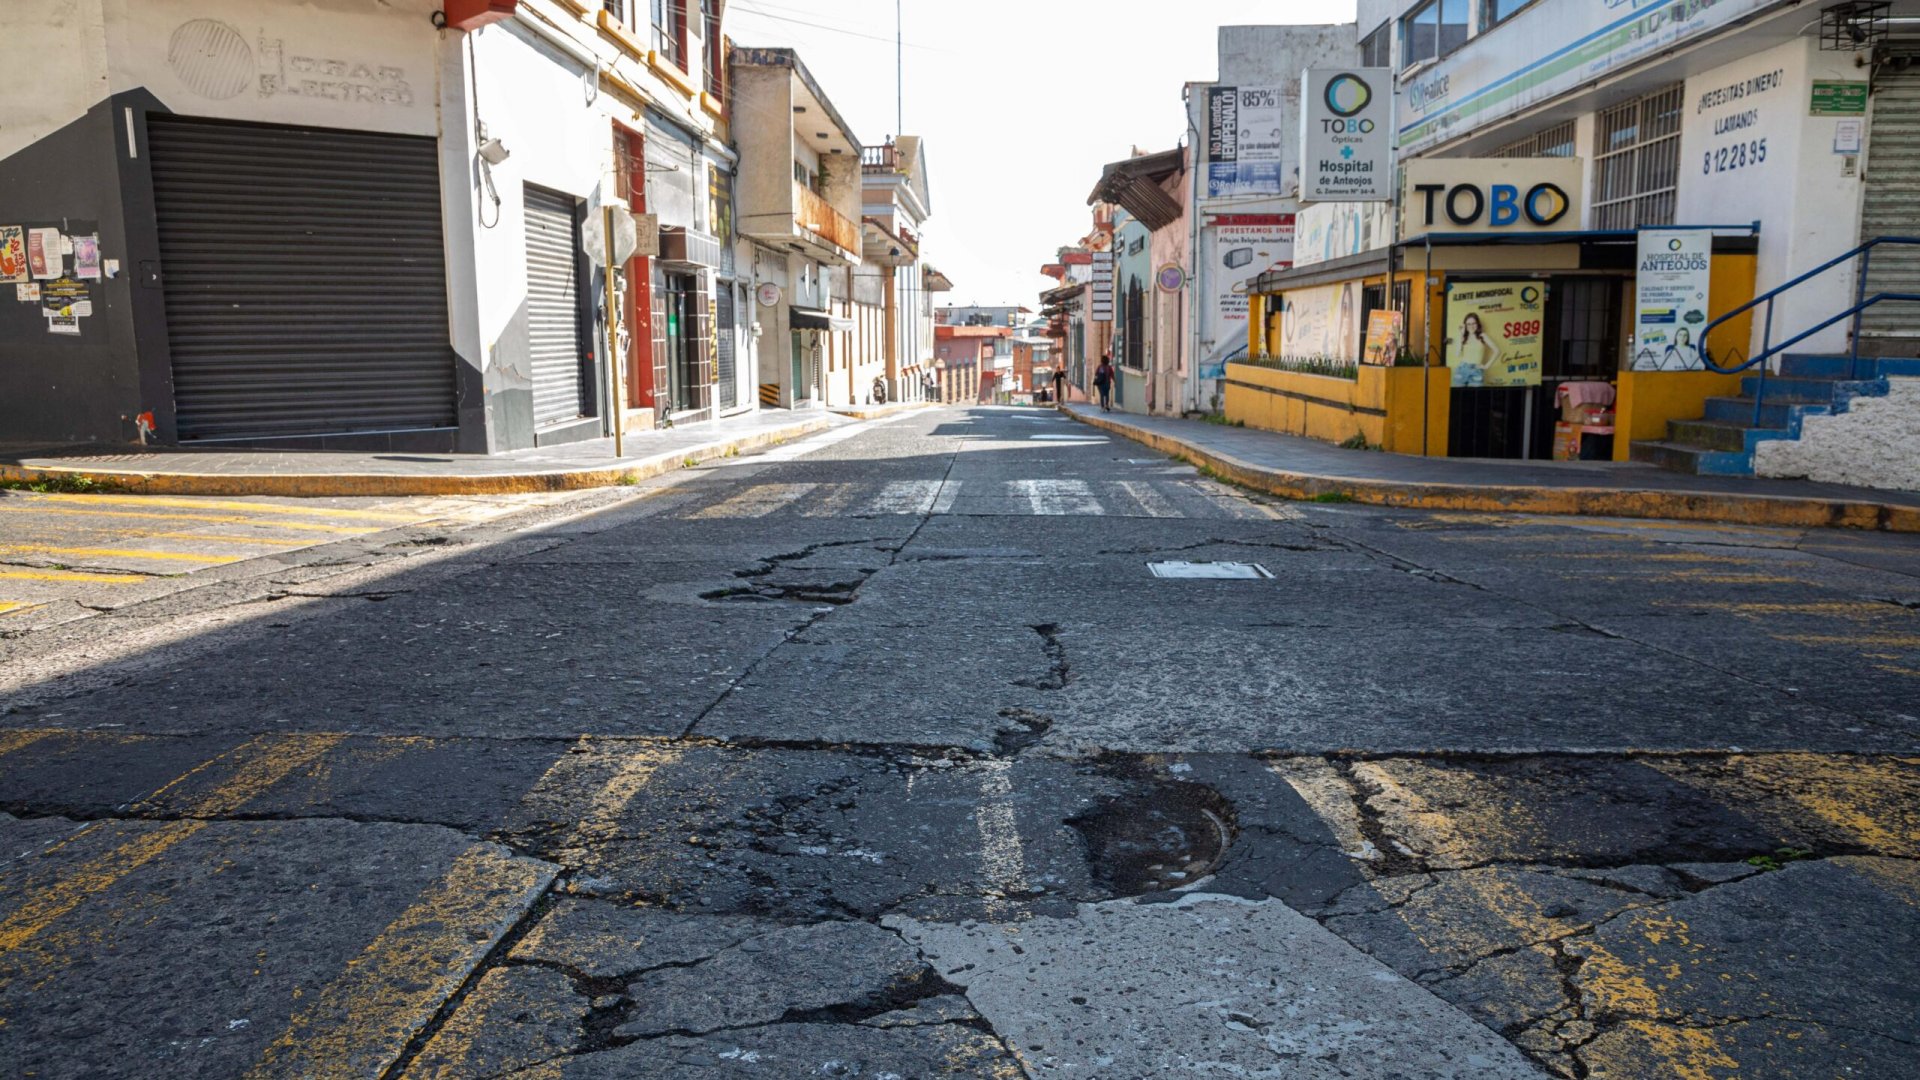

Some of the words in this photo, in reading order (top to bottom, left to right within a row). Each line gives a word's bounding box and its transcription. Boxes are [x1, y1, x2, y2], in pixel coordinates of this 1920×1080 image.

[1210, 95, 1222, 128] vendas
[1320, 118, 1375, 134] TOBO
[1714, 108, 1759, 136] LLAMANOS
[1210, 128, 1222, 141] Lo
[1210, 141, 1222, 156] No
[1319, 159, 1374, 175] Hospital
[1319, 176, 1331, 185] de
[1333, 176, 1373, 187] Anteojos
[1315, 187, 1324, 195] G.
[1324, 187, 1350, 195] Zamora
[1413, 182, 1570, 227] TOBO
[1692, 252, 1704, 260] DE
[1640, 260, 1707, 271] ANTEOJOS
[1475, 288, 1513, 298] MONOFOCAL
[1503, 320, 1540, 338] $899
